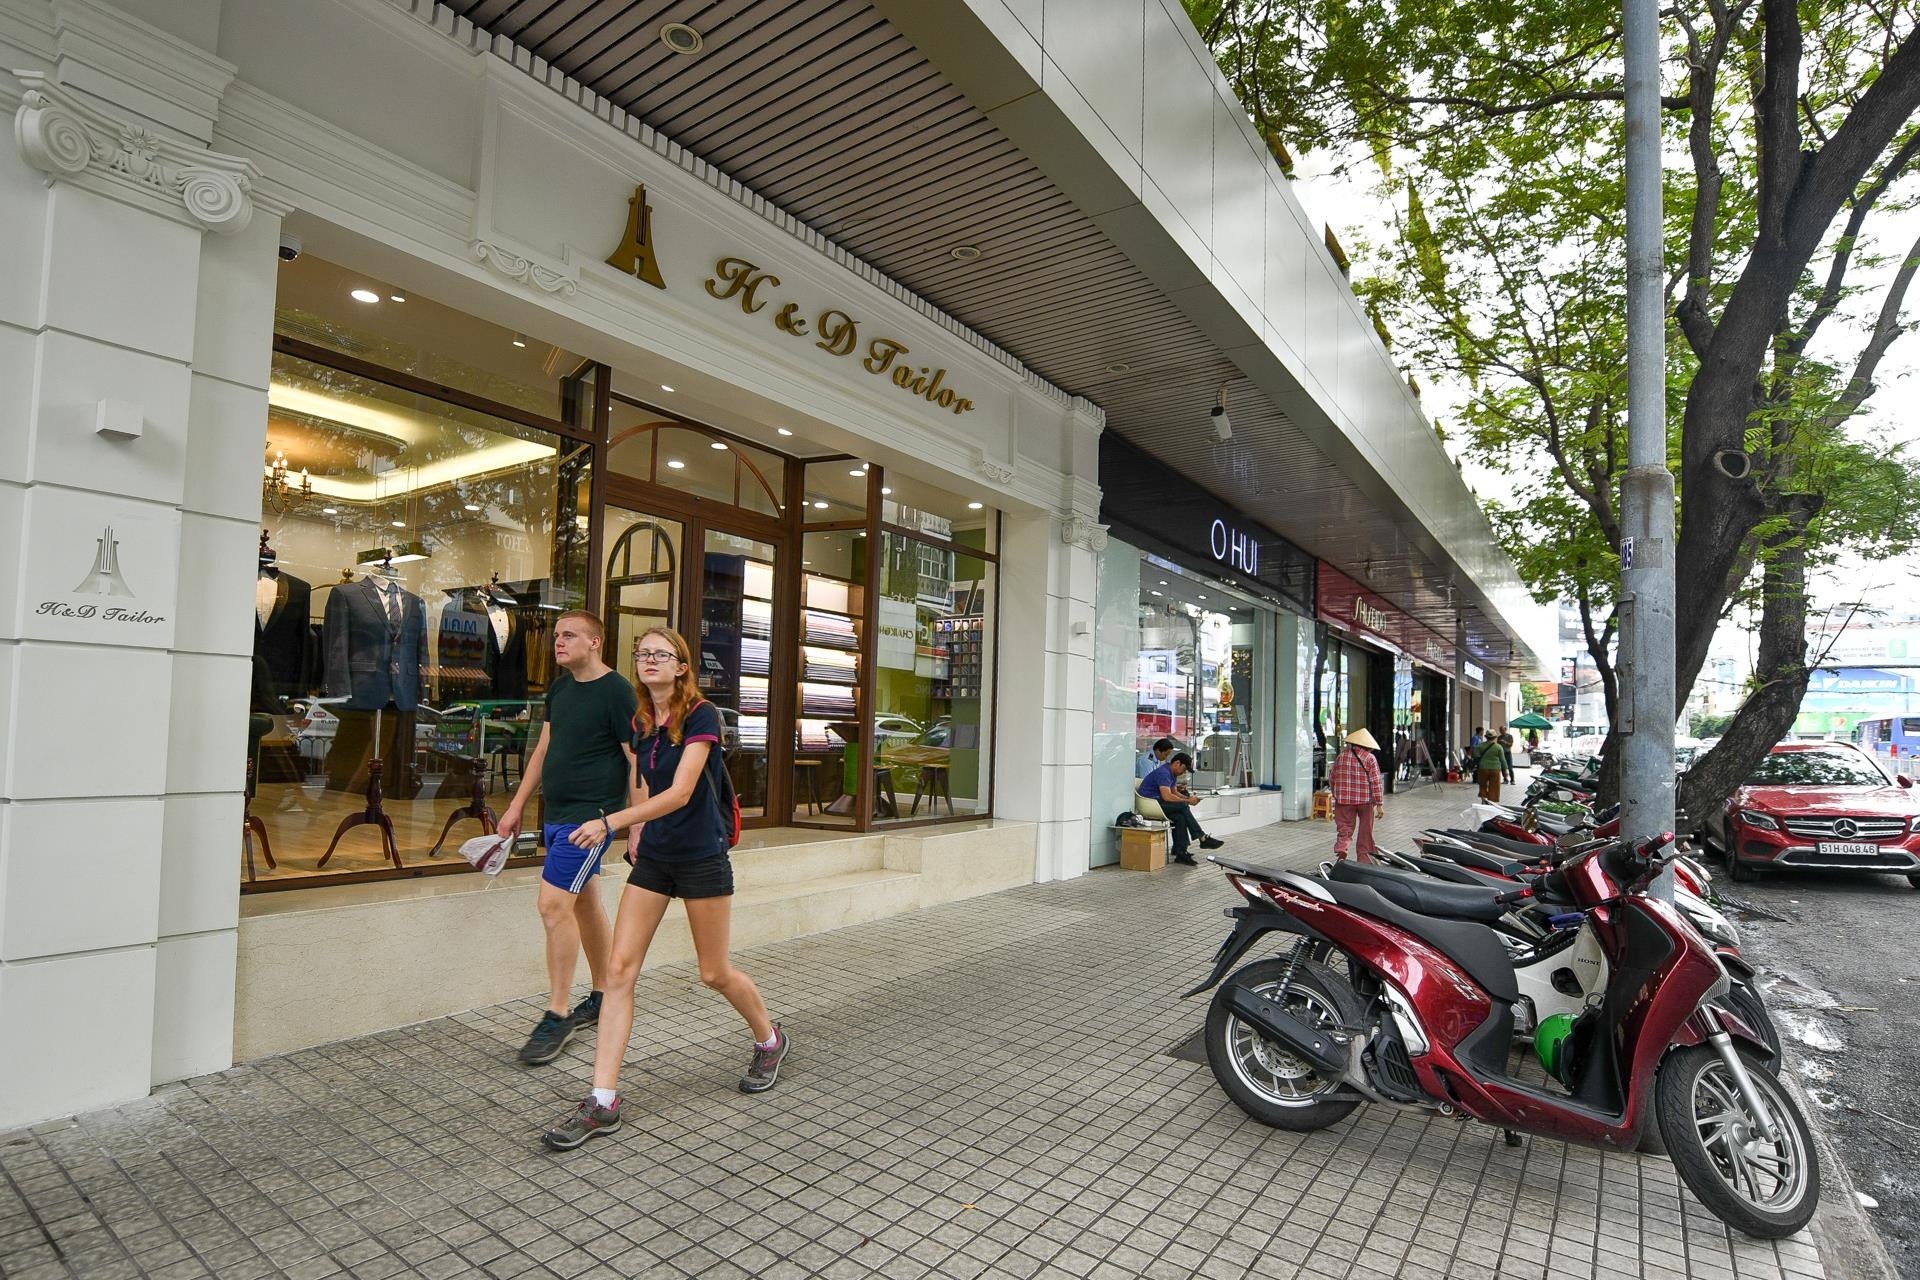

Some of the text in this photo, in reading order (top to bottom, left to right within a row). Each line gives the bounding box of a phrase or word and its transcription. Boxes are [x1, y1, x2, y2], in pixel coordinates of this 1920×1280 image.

[863, 338, 975, 415] Tailor
[35, 601, 167, 624] H&D Tailor
